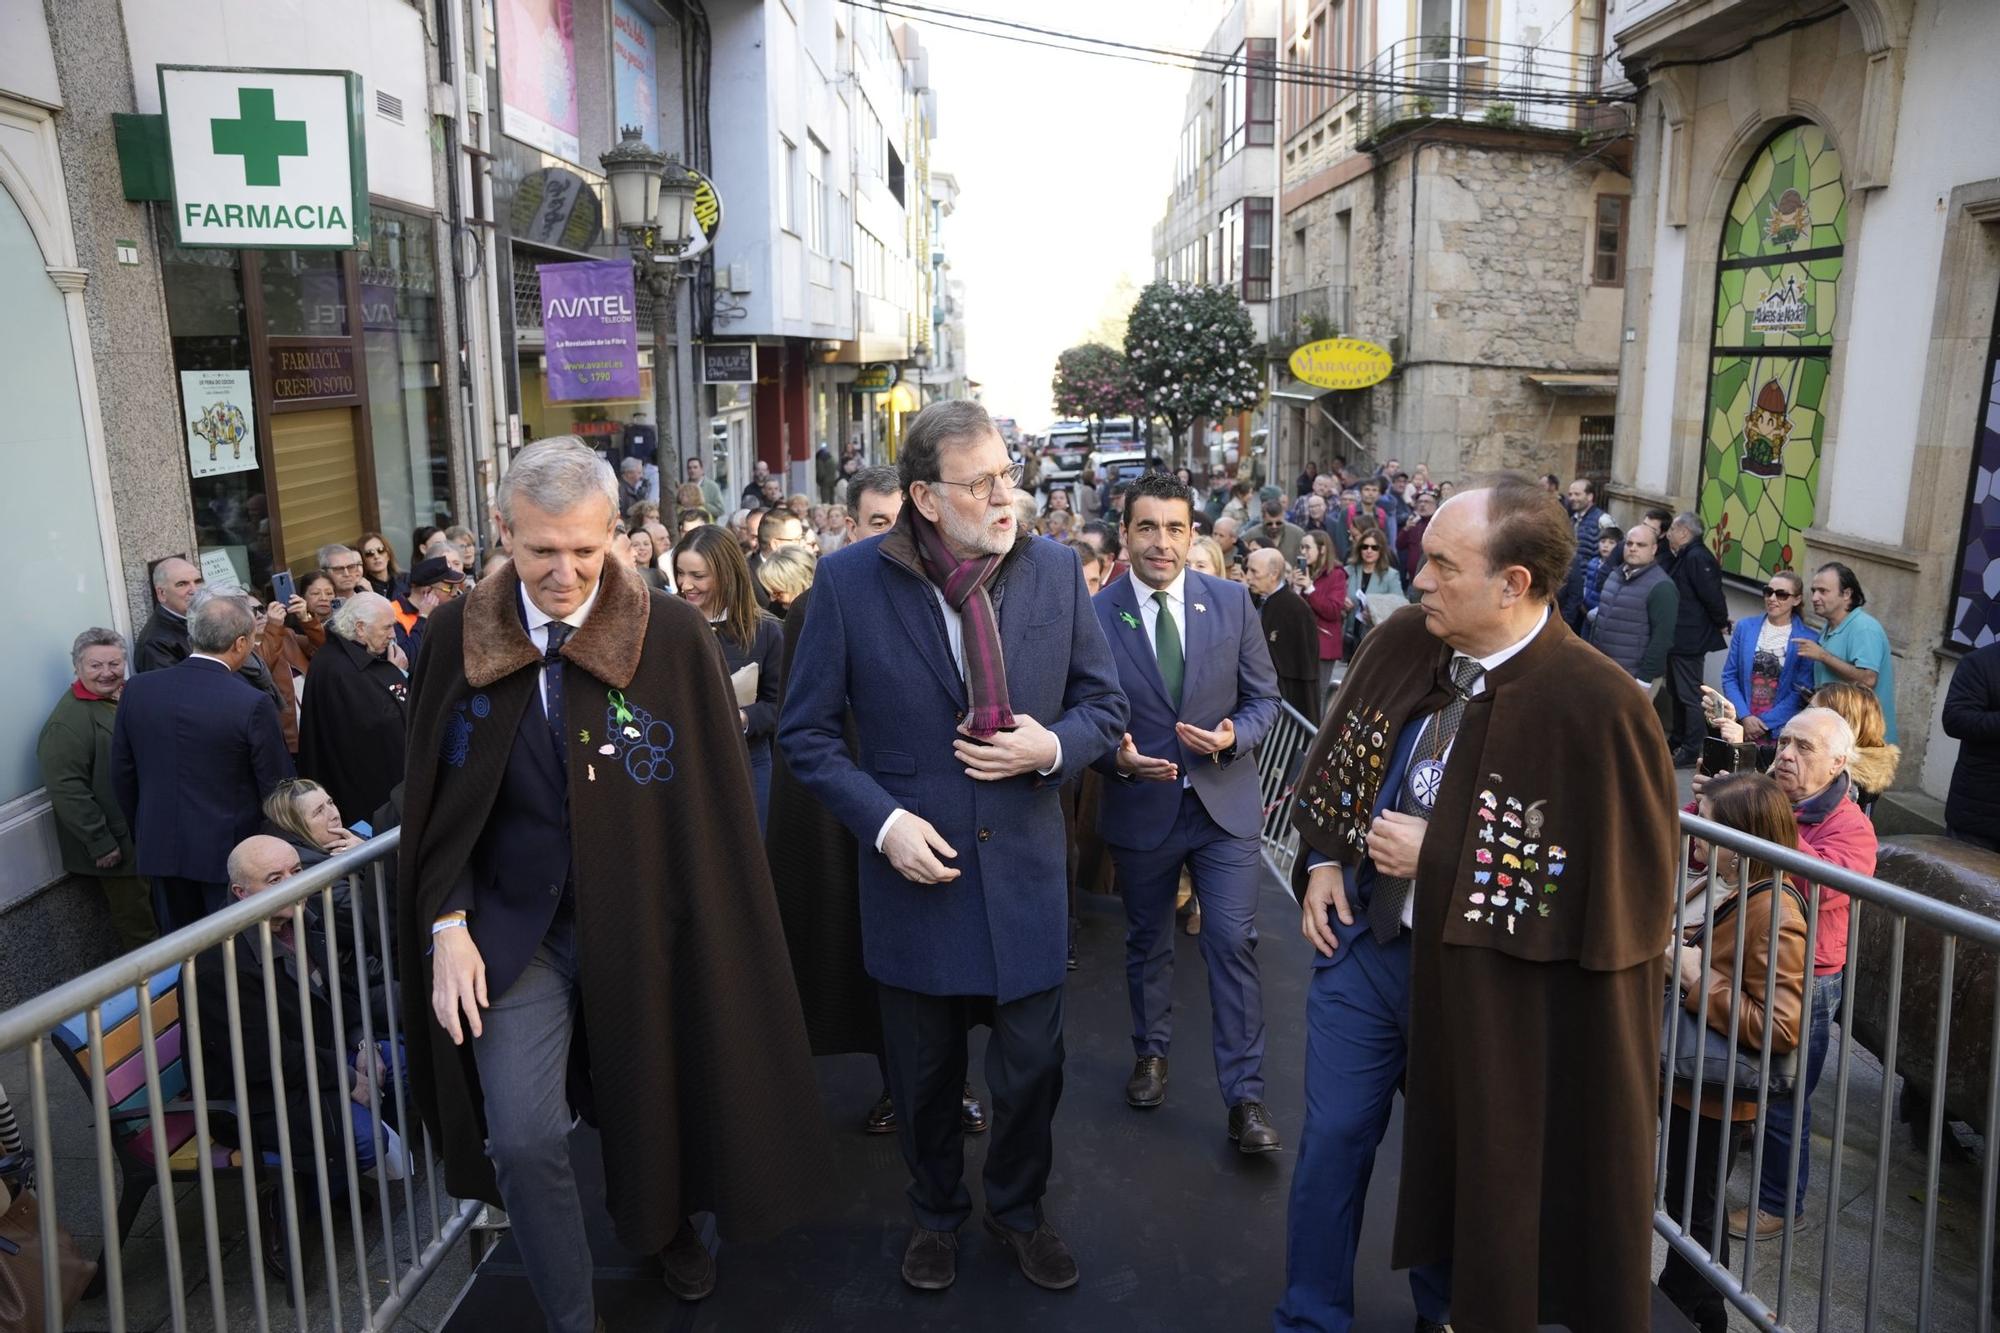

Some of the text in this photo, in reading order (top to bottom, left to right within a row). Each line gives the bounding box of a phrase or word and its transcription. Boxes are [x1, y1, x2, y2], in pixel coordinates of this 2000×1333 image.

[688, 170, 719, 234] AZAR
[184, 203, 347, 230] FARMACIA
[125, 249, 130, 262] 1
[547, 295, 632, 319] AVATEL
[1755, 306, 1776, 323] Aldeas
[1777, 310, 1785, 322] de
[601, 315, 633, 324] TELECOM
[556, 340, 564, 348] La
[565, 339, 596, 348] Revolución
[1305, 342, 1381, 357] FRUTERIA
[281, 352, 341, 370] FARMACIA
[564, 360, 624, 371] www.avatel.es
[592, 371, 611, 381] 1790
[275, 375, 353, 397] CRESPO SOTO
